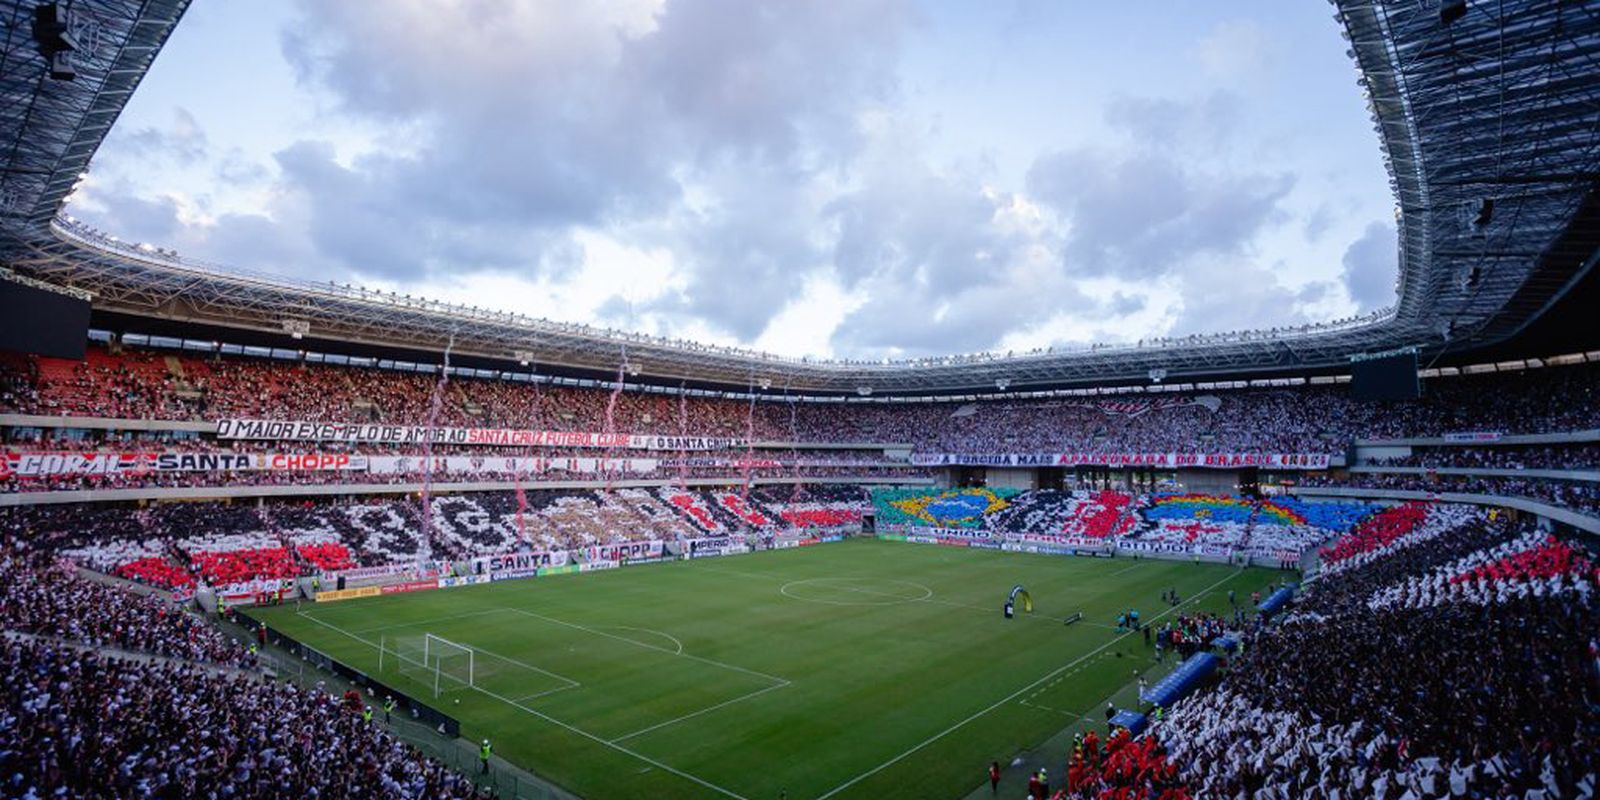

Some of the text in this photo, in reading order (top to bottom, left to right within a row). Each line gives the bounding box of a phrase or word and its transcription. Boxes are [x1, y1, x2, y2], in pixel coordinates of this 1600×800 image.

[217, 420, 630, 447] O MAIOR EXEMPLO DE AMOR AO SANTA CRUZ FUTEBOL CLUBE
[657, 437, 664, 448] O
[668, 438, 704, 449] SANTA
[707, 439, 732, 449] CRUZ
[16, 455, 120, 475] CORAL
[158, 454, 250, 470] SANTA
[272, 454, 349, 469] CHOPP
[956, 455, 1011, 465] TORCIDA
[1017, 454, 1053, 465] MAIS
[1059, 453, 1167, 464] APAIXONADA
[1175, 453, 1197, 464] DO
[1205, 453, 1276, 465] BRASIL
[600, 543, 651, 560] CHOPP
[691, 538, 730, 551] MPERIO
[490, 553, 552, 571] SANTA
